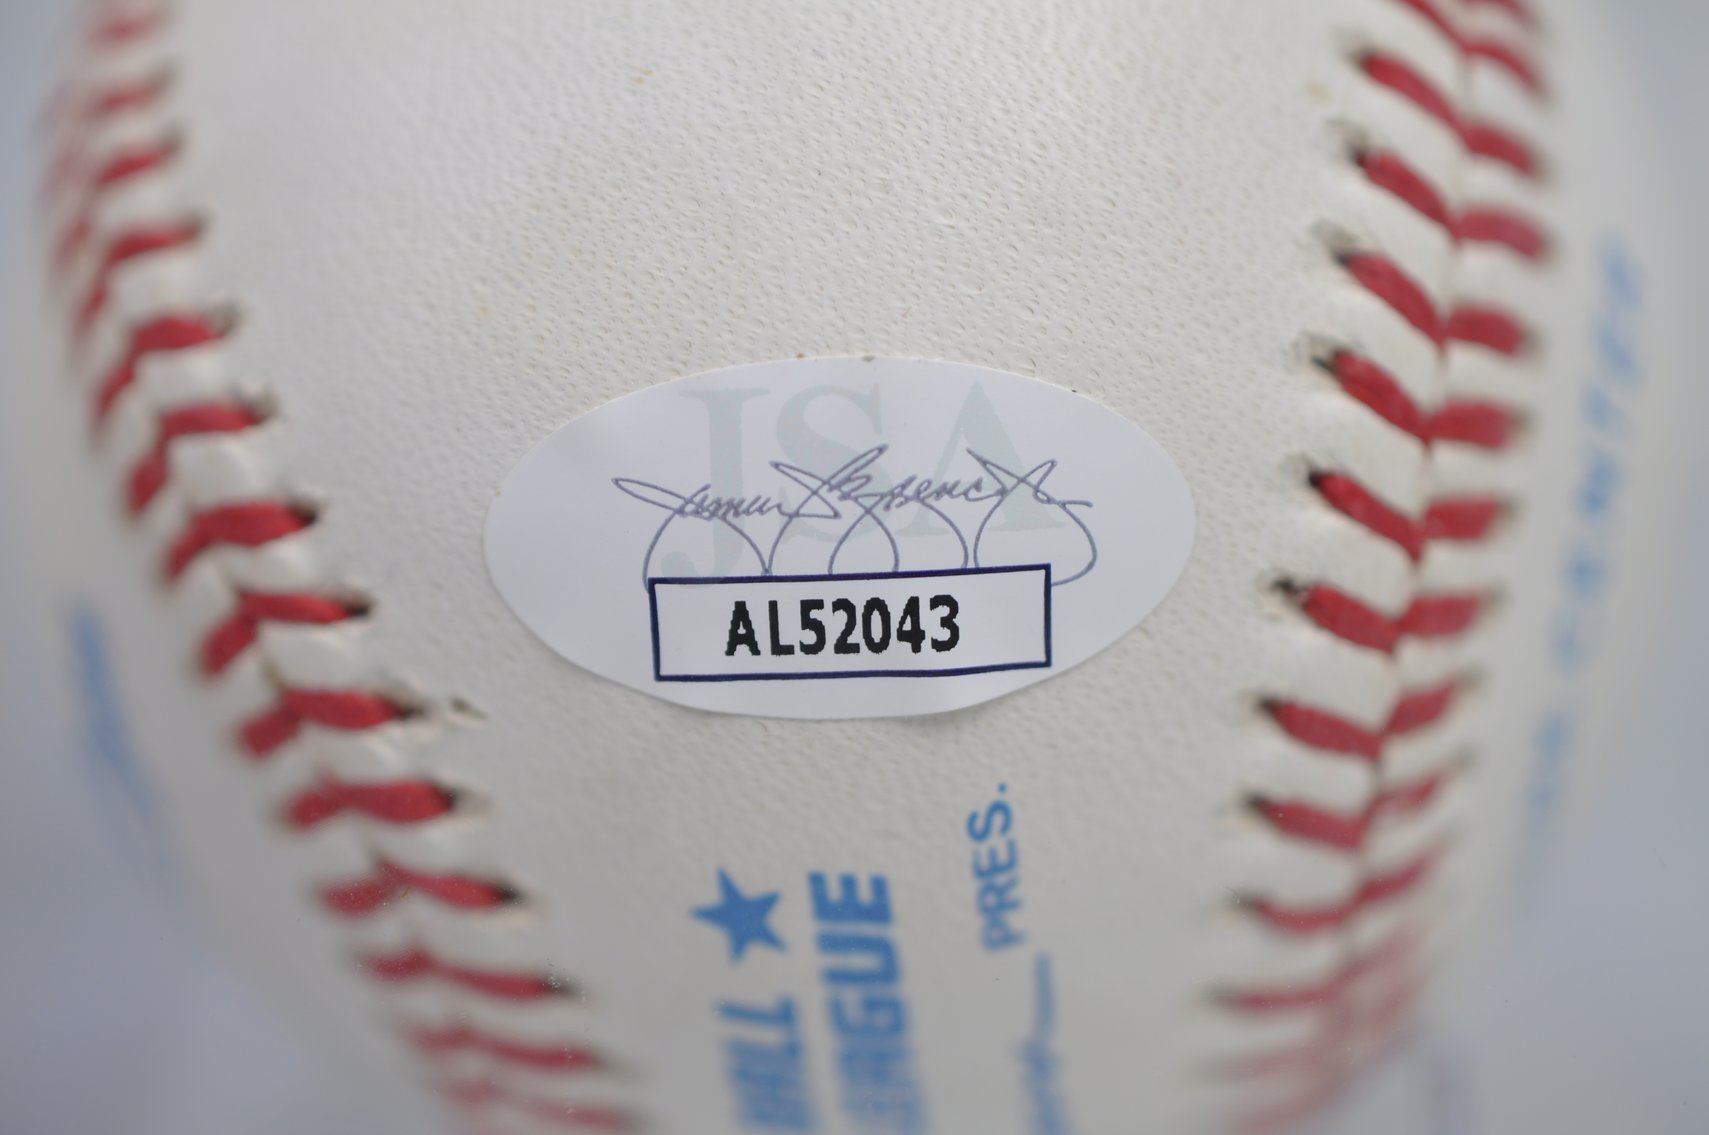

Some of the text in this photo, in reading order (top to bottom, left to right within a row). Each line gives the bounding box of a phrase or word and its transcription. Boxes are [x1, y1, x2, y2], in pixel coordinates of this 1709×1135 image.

[661, 379, 1067, 580] JSA
[725, 594, 961, 657] AL52043
[966, 781, 1029, 952] PRES.
